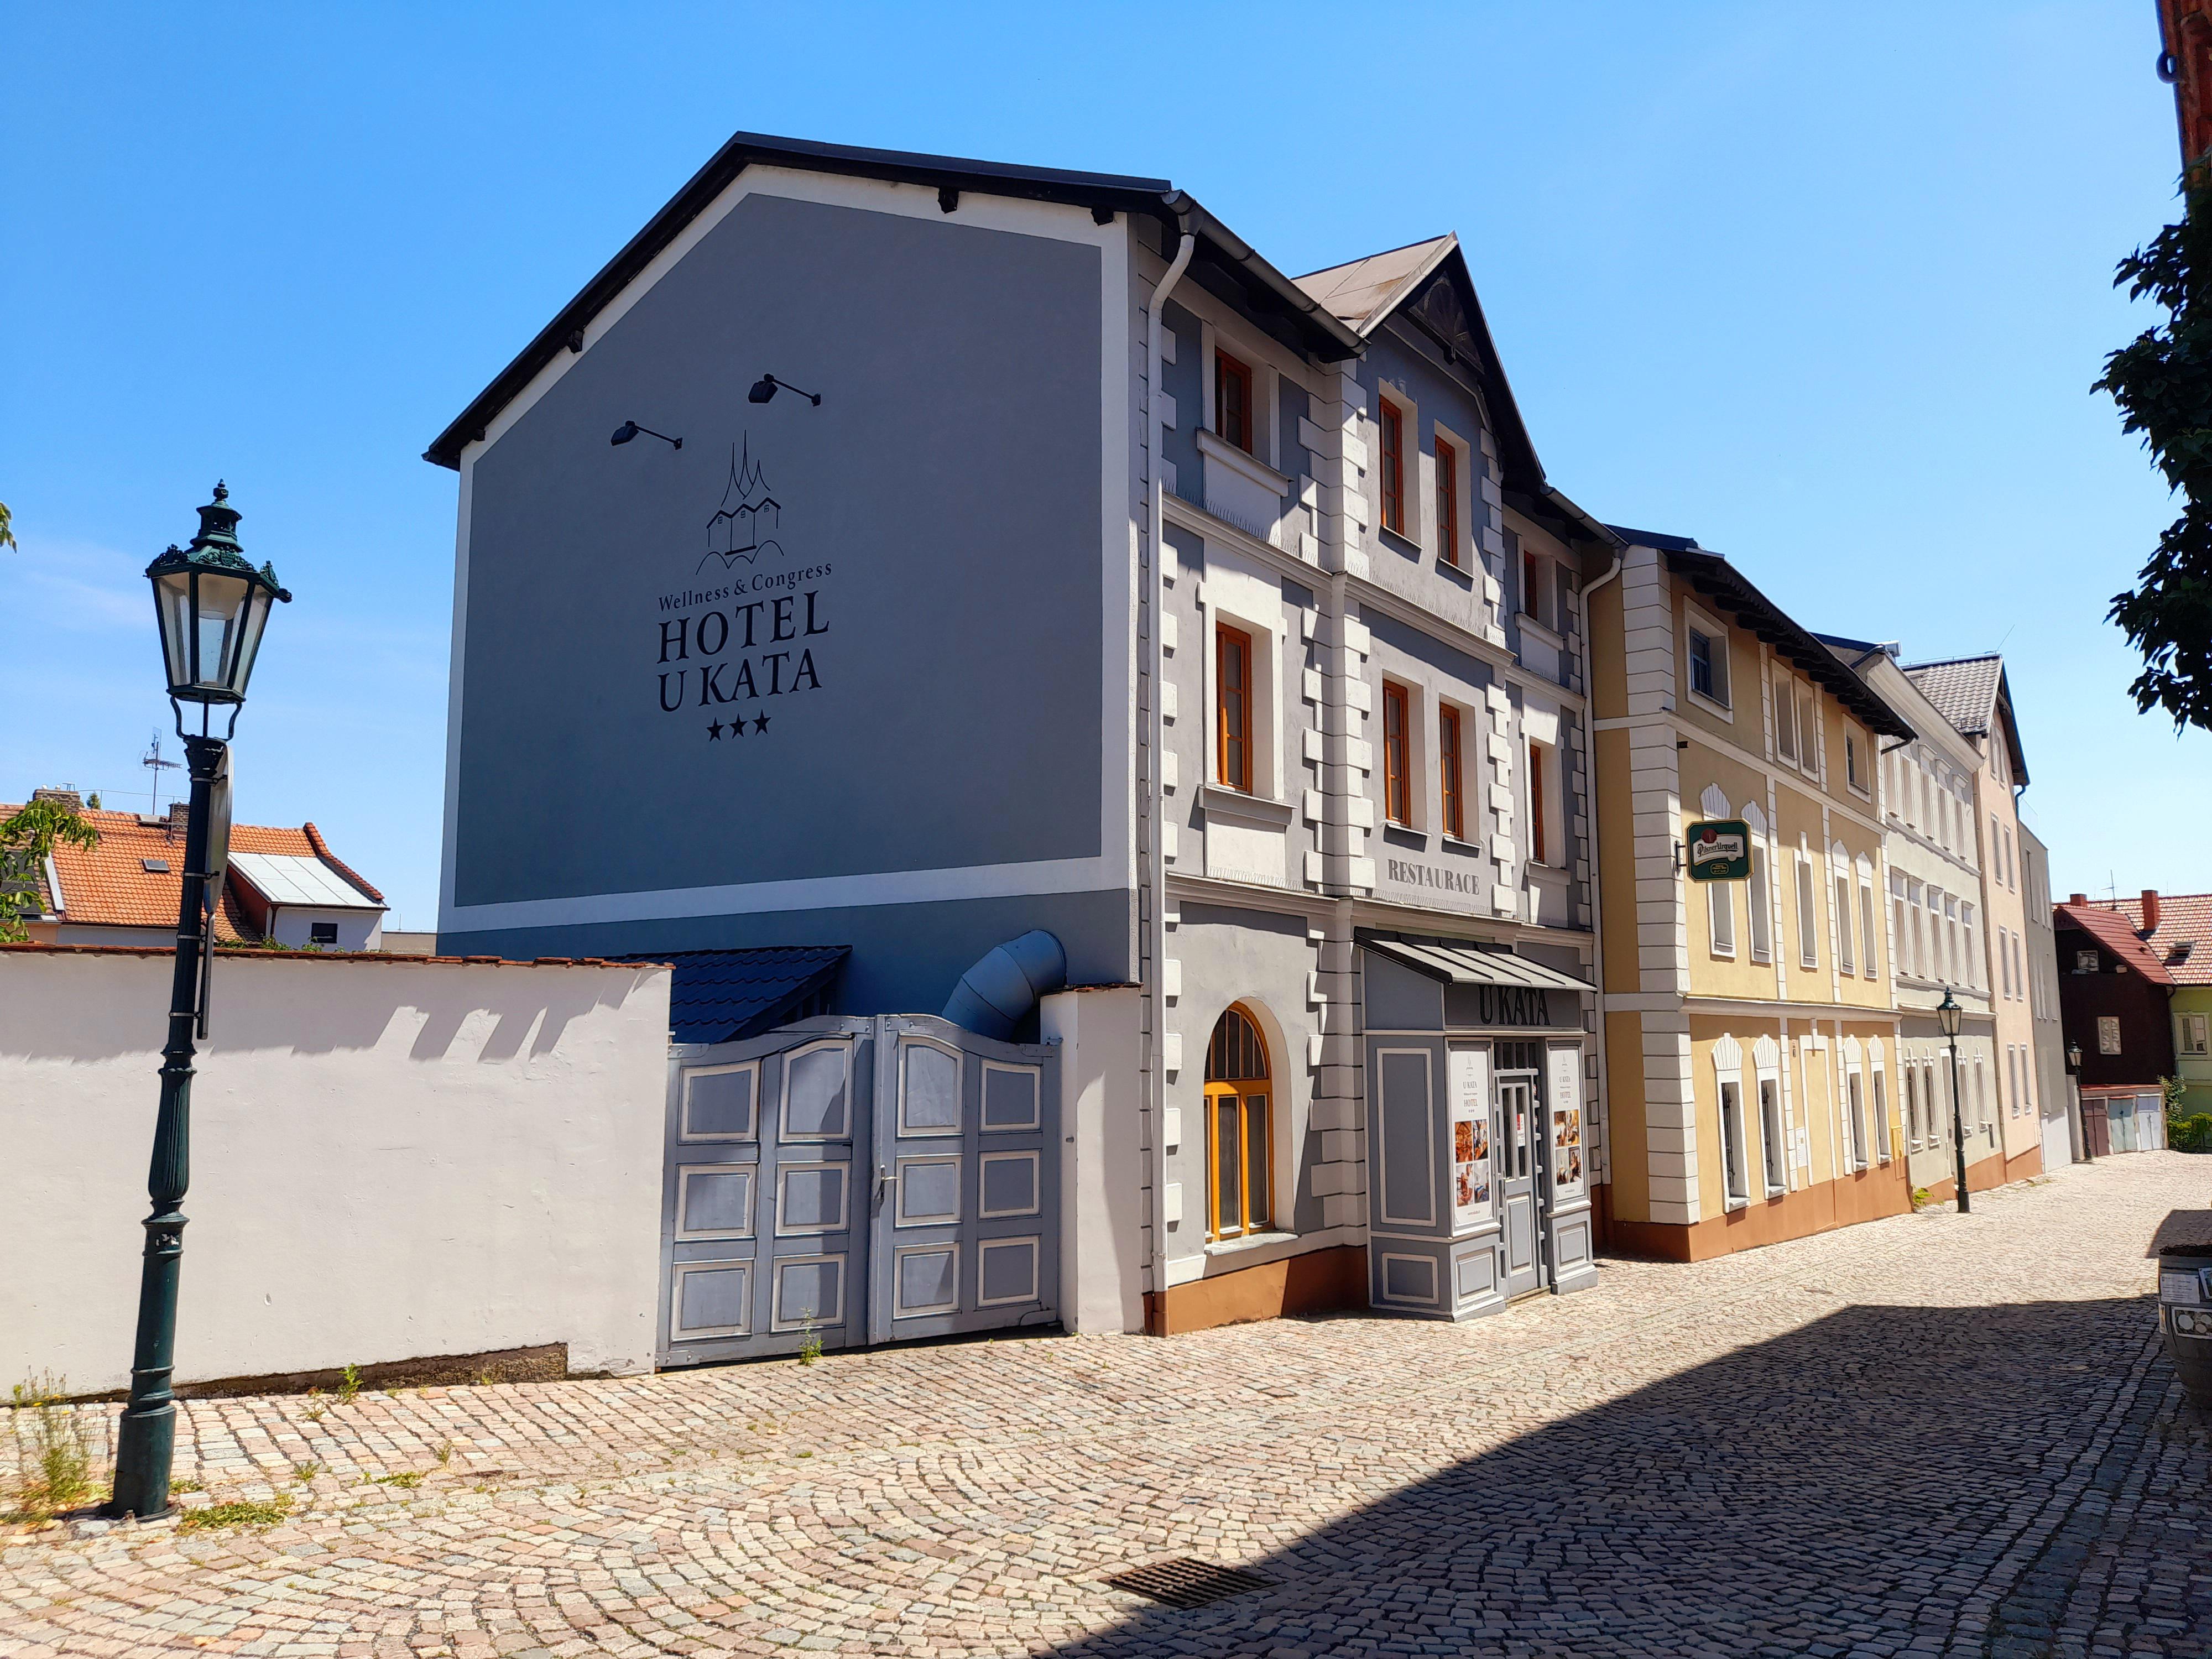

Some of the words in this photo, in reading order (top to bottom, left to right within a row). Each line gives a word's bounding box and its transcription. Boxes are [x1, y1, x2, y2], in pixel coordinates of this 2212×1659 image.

[659, 587, 729, 612] Wellness
[734, 580, 748, 596] &
[752, 562, 832, 590] Congress
[656, 590, 830, 664] HOTEL
[1697, 843, 1717, 858] Pilsner
[1387, 859, 1480, 895] RESTAURACE
[1464, 1099, 1478, 1107] HOTEL
